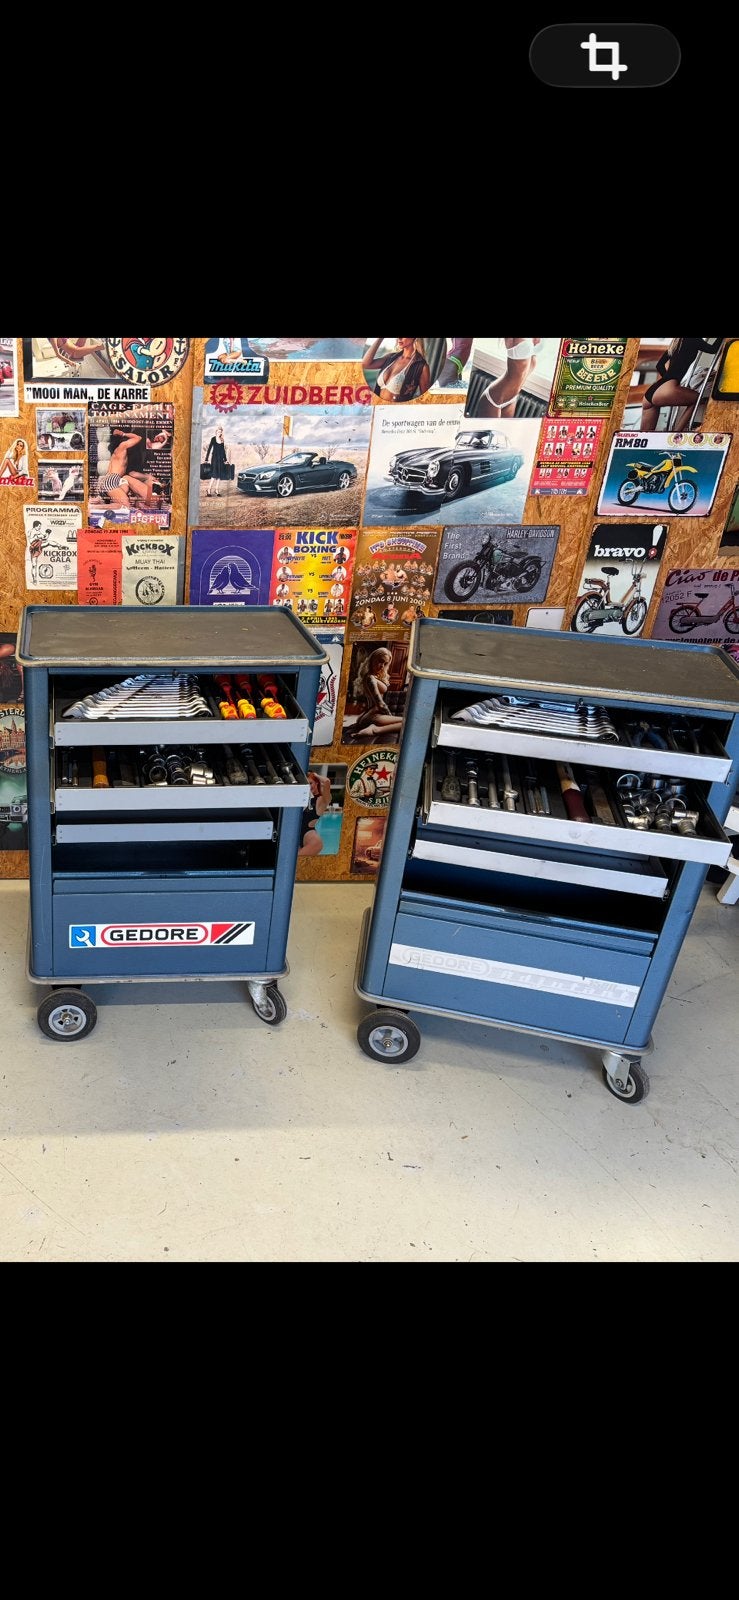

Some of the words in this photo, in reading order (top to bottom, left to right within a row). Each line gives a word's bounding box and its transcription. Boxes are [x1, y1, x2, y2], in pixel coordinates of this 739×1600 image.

[97, 388, 111, 399] DE
[114, 388, 149, 400] KARRE
[248, 386, 372, 405] ZUIDBERG
[382, 419, 389, 427] De
[391, 420, 425, 428] sportwagen
[296, 531, 339, 545] KICK
[446, 532, 460, 540] The
[506, 529, 555, 539] HARLEY-DAVIDSON
[125, 543, 175, 556] KICKBOX
[293, 545, 337, 554] BOXING
[712, 570, 729, 582] de
[355, 596, 386, 607] ZONDAG
[109, 927, 199, 942] GEDORE
